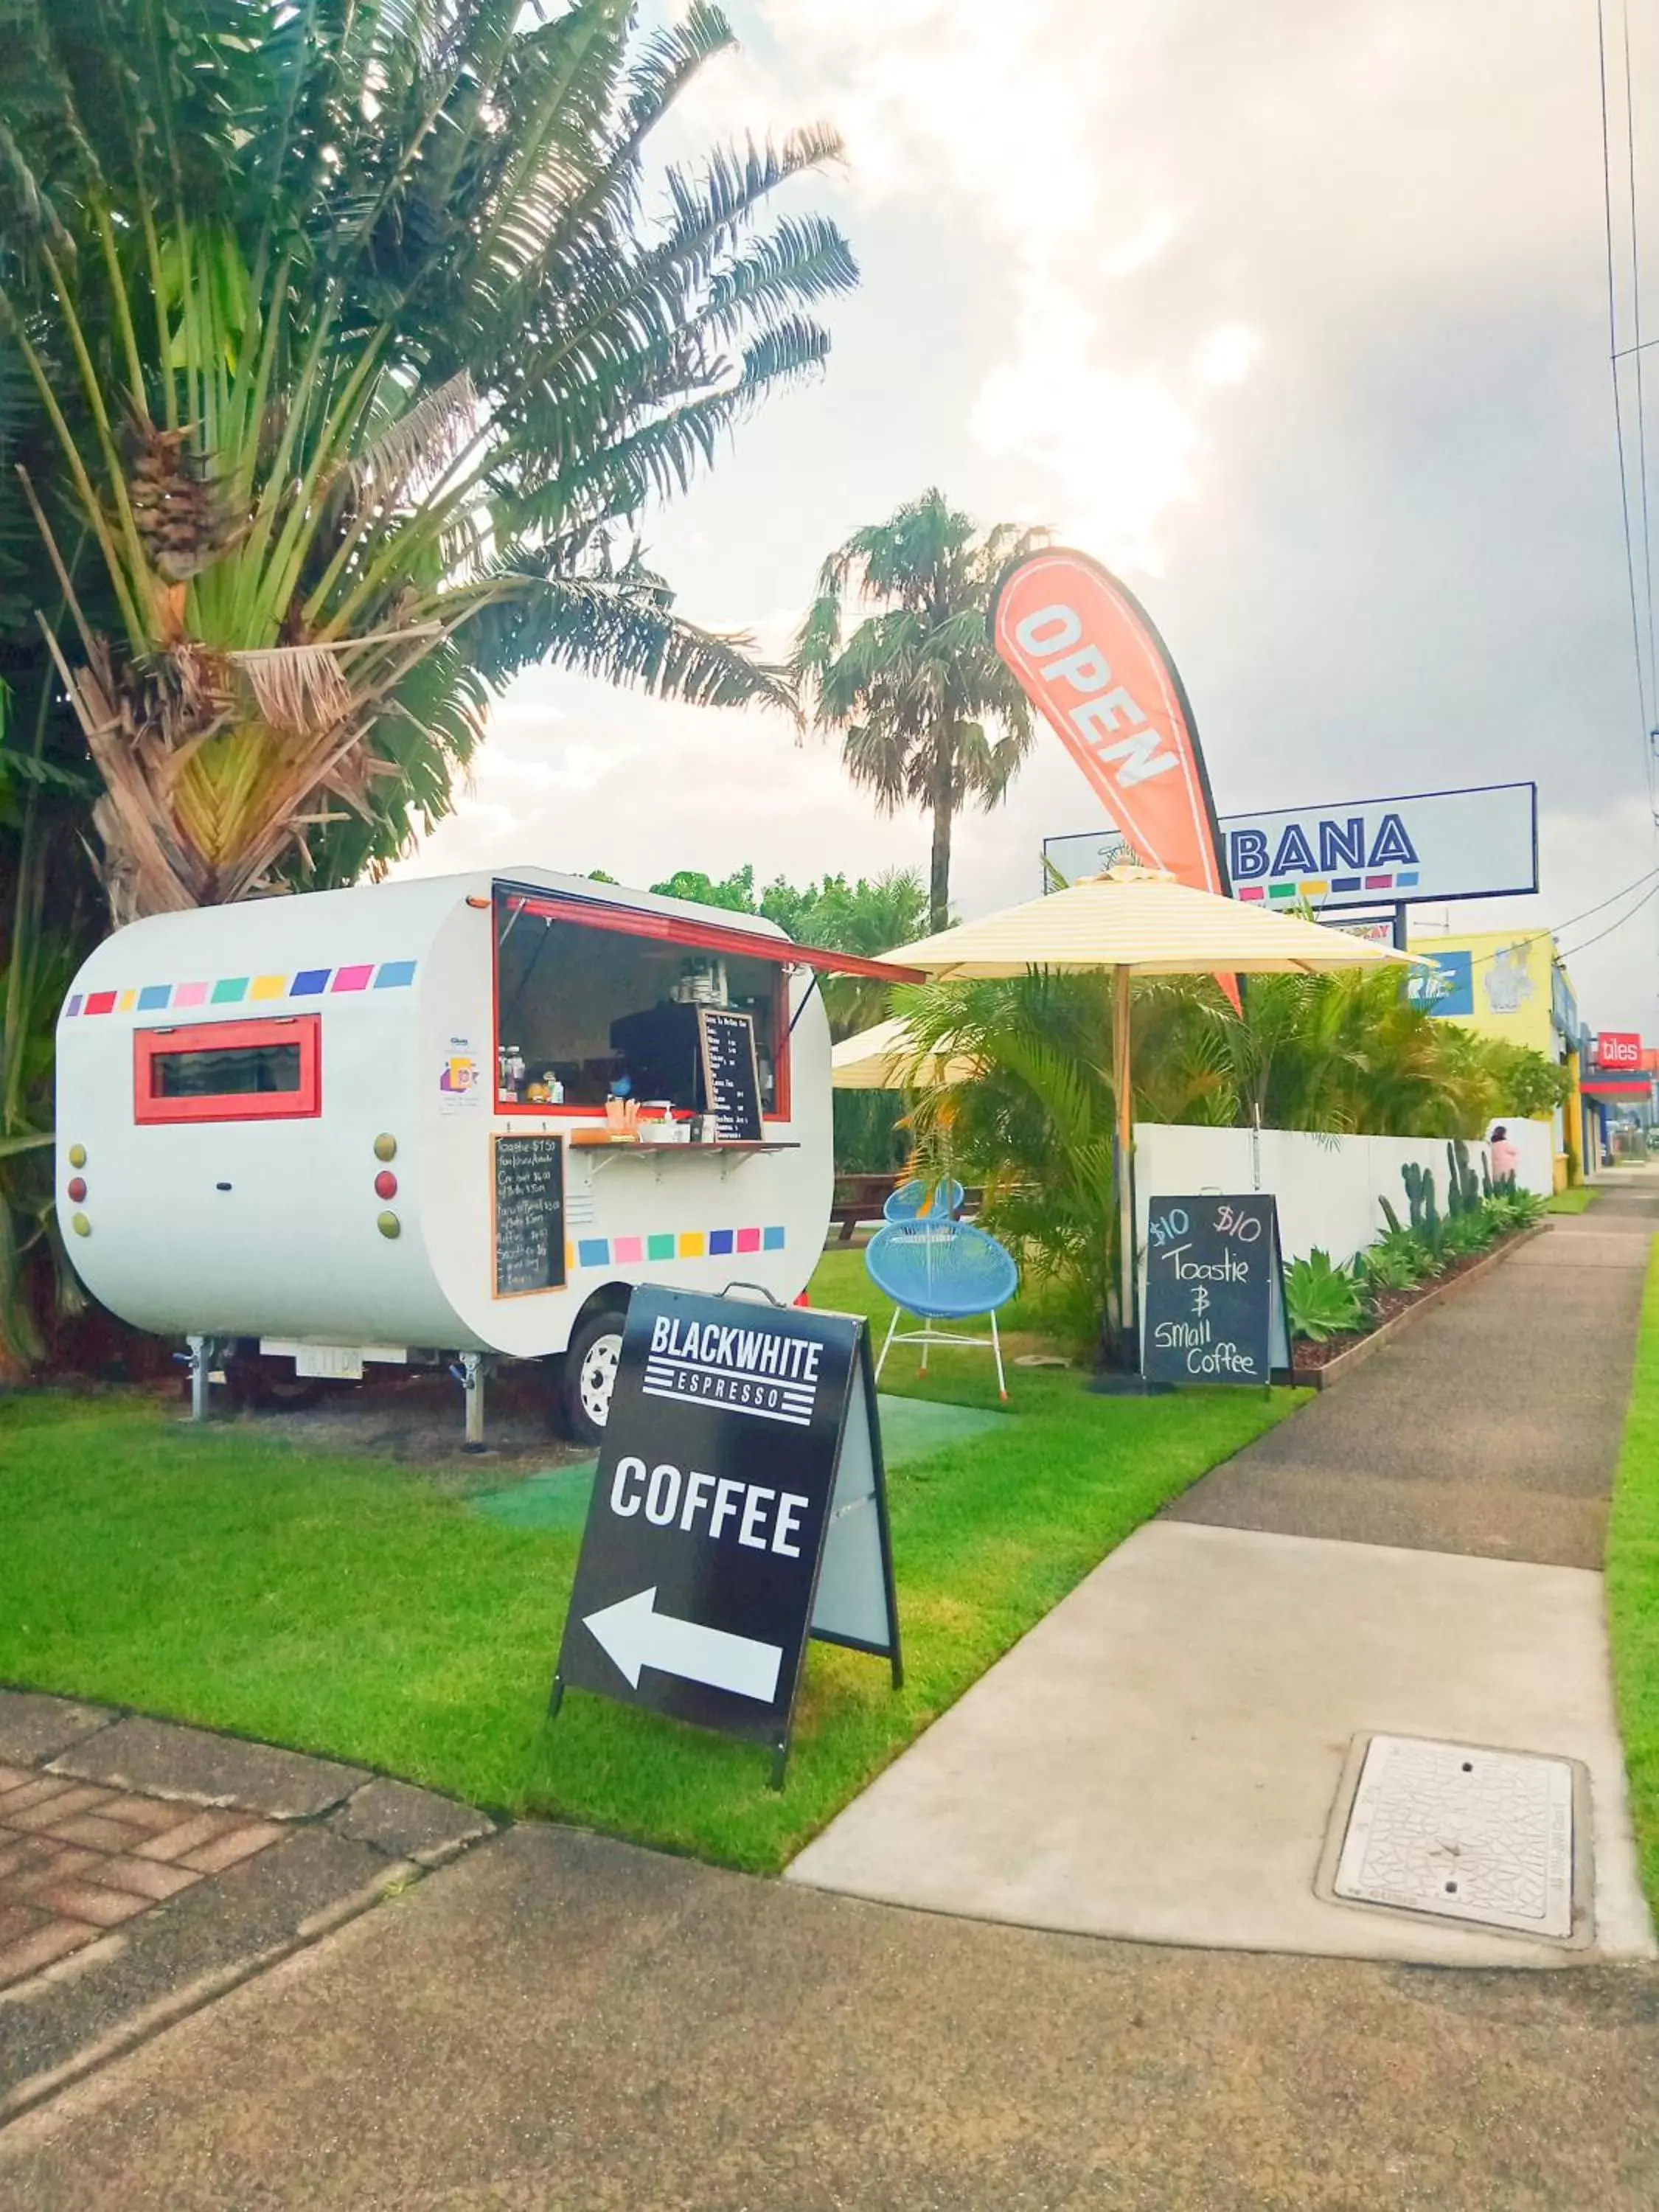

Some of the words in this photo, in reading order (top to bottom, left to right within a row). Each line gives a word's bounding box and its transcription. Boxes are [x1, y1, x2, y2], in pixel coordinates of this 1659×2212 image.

[1016, 604, 1180, 789] OPEN
[1222, 813, 1419, 882] BANA
[1602, 1037, 1638, 1062] tiles
[1150, 1208, 1189, 1247] $10
[1213, 1205, 1262, 1242] $10
[1161, 1242, 1250, 1283] Toastie
[650, 1316, 824, 1382] BLACKWHITE
[1154, 1319, 1211, 1349] Small
[1186, 1343, 1258, 1375] Coffee
[678, 1371, 779, 1408] ESPRESSO
[610, 1455, 809, 1558] COFFEE
